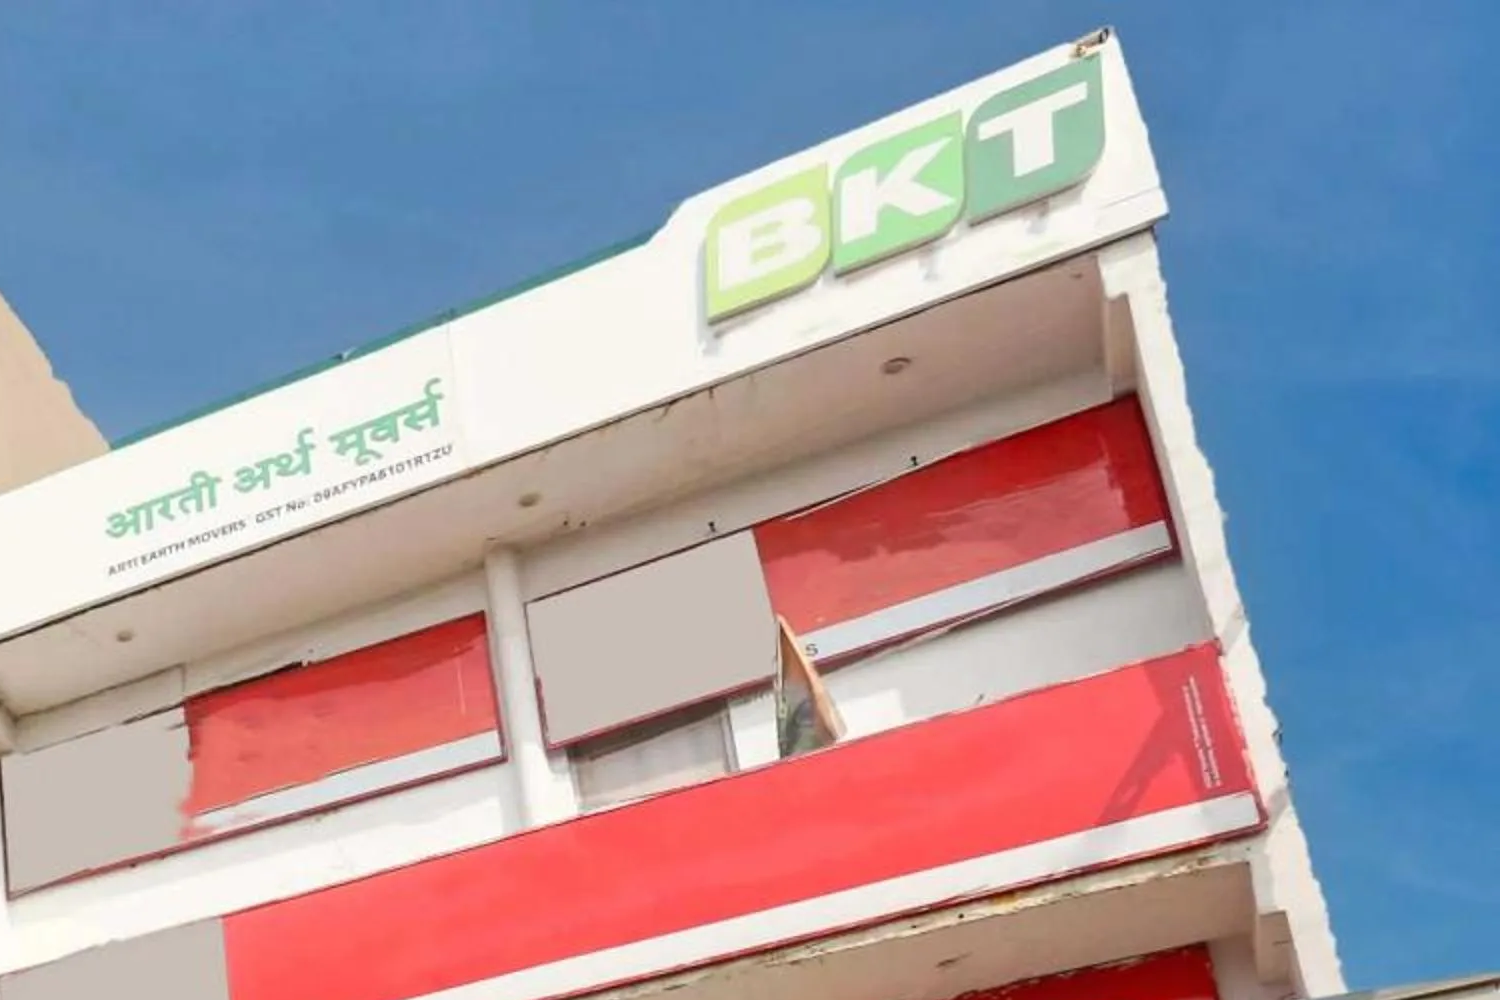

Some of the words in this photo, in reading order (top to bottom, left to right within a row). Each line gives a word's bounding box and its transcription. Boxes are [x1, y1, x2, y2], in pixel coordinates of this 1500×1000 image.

[718, 81, 1088, 292] BKT
[105, 470, 222, 538] आरती
[233, 427, 315, 493] अर्थ
[328, 378, 444, 466] मूवर्स
[108, 558, 138, 576] ARTI
[140, 541, 186, 565] EARTH
[187, 519, 247, 547] MOVERS
[255, 506, 282, 523] GST
